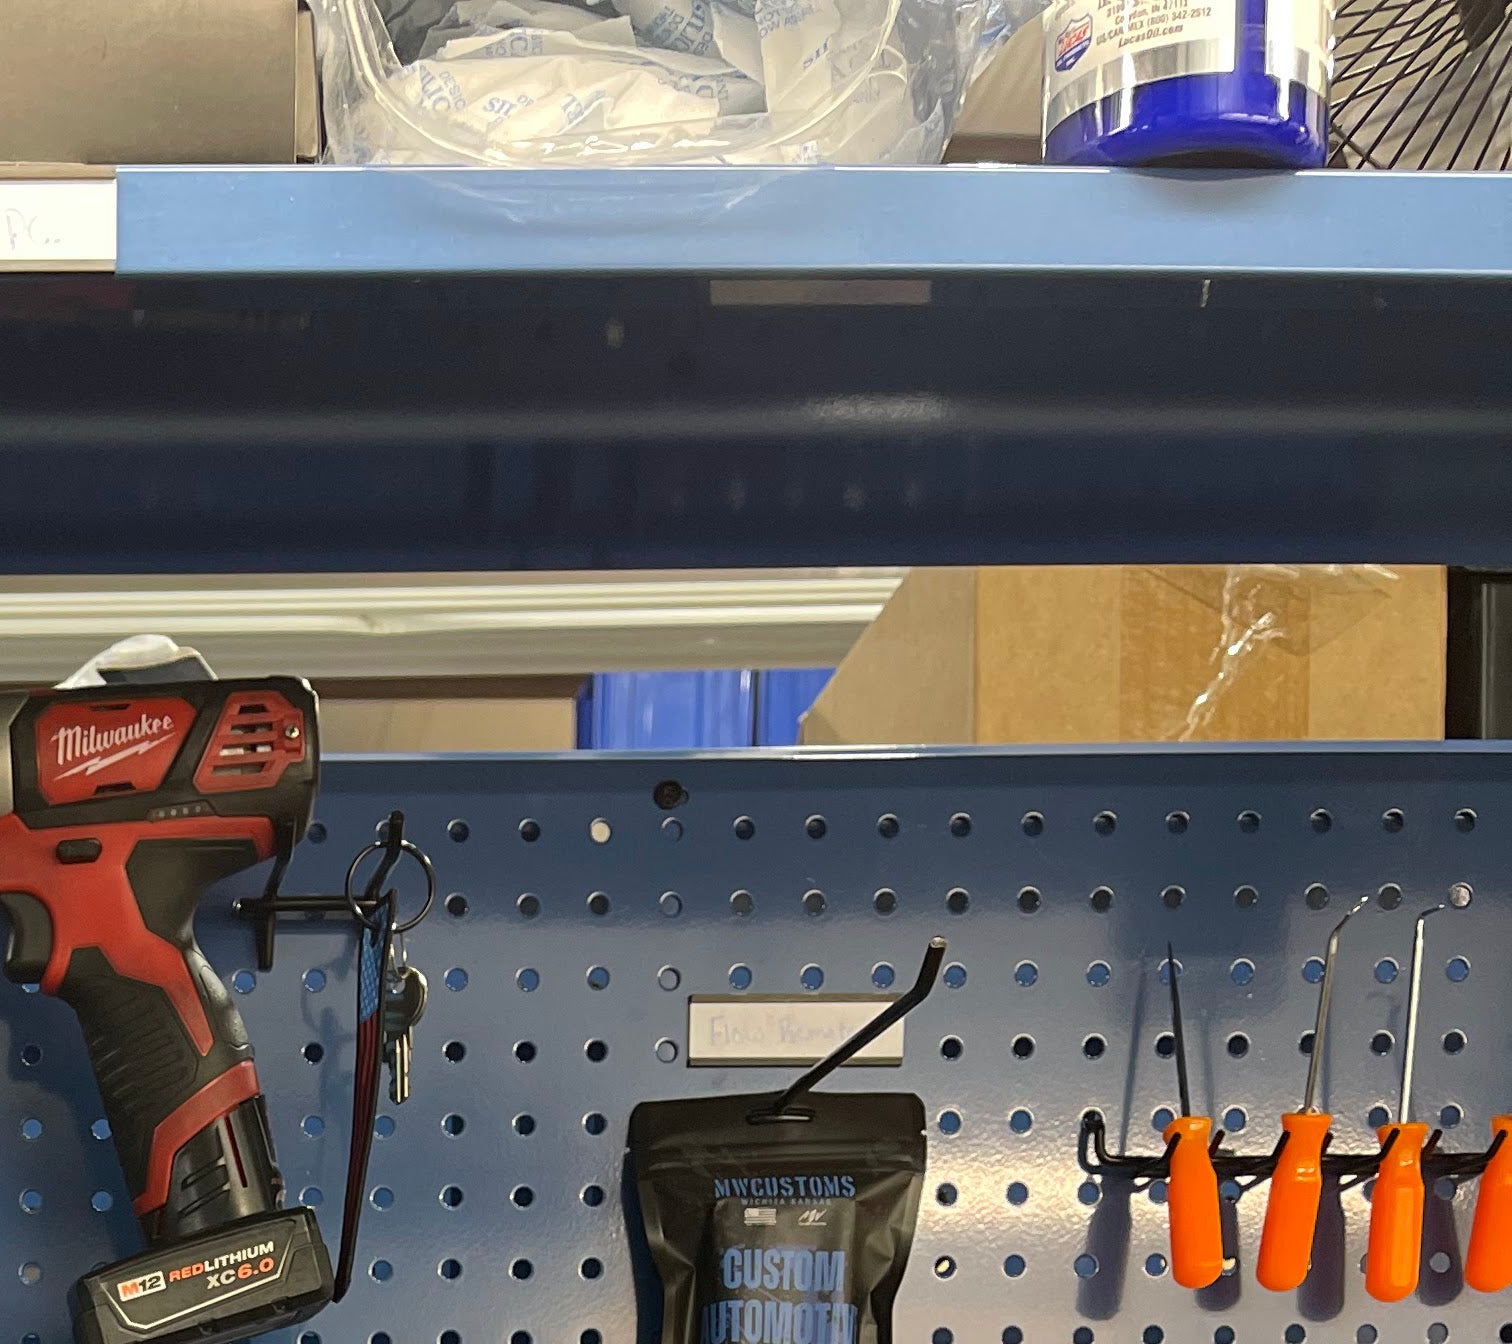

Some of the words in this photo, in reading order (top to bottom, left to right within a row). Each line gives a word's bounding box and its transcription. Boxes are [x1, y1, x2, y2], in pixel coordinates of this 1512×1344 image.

[49, 713, 175, 766] Milwaukee
[714, 1175, 856, 1198] MWCUSTOMS
[120, 1274, 164, 1299] M12
[168, 1240, 274, 1283] REDLITHIUM
[205, 1256, 275, 1290] XC6.0
[721, 1248, 846, 1292] CUSTOM
